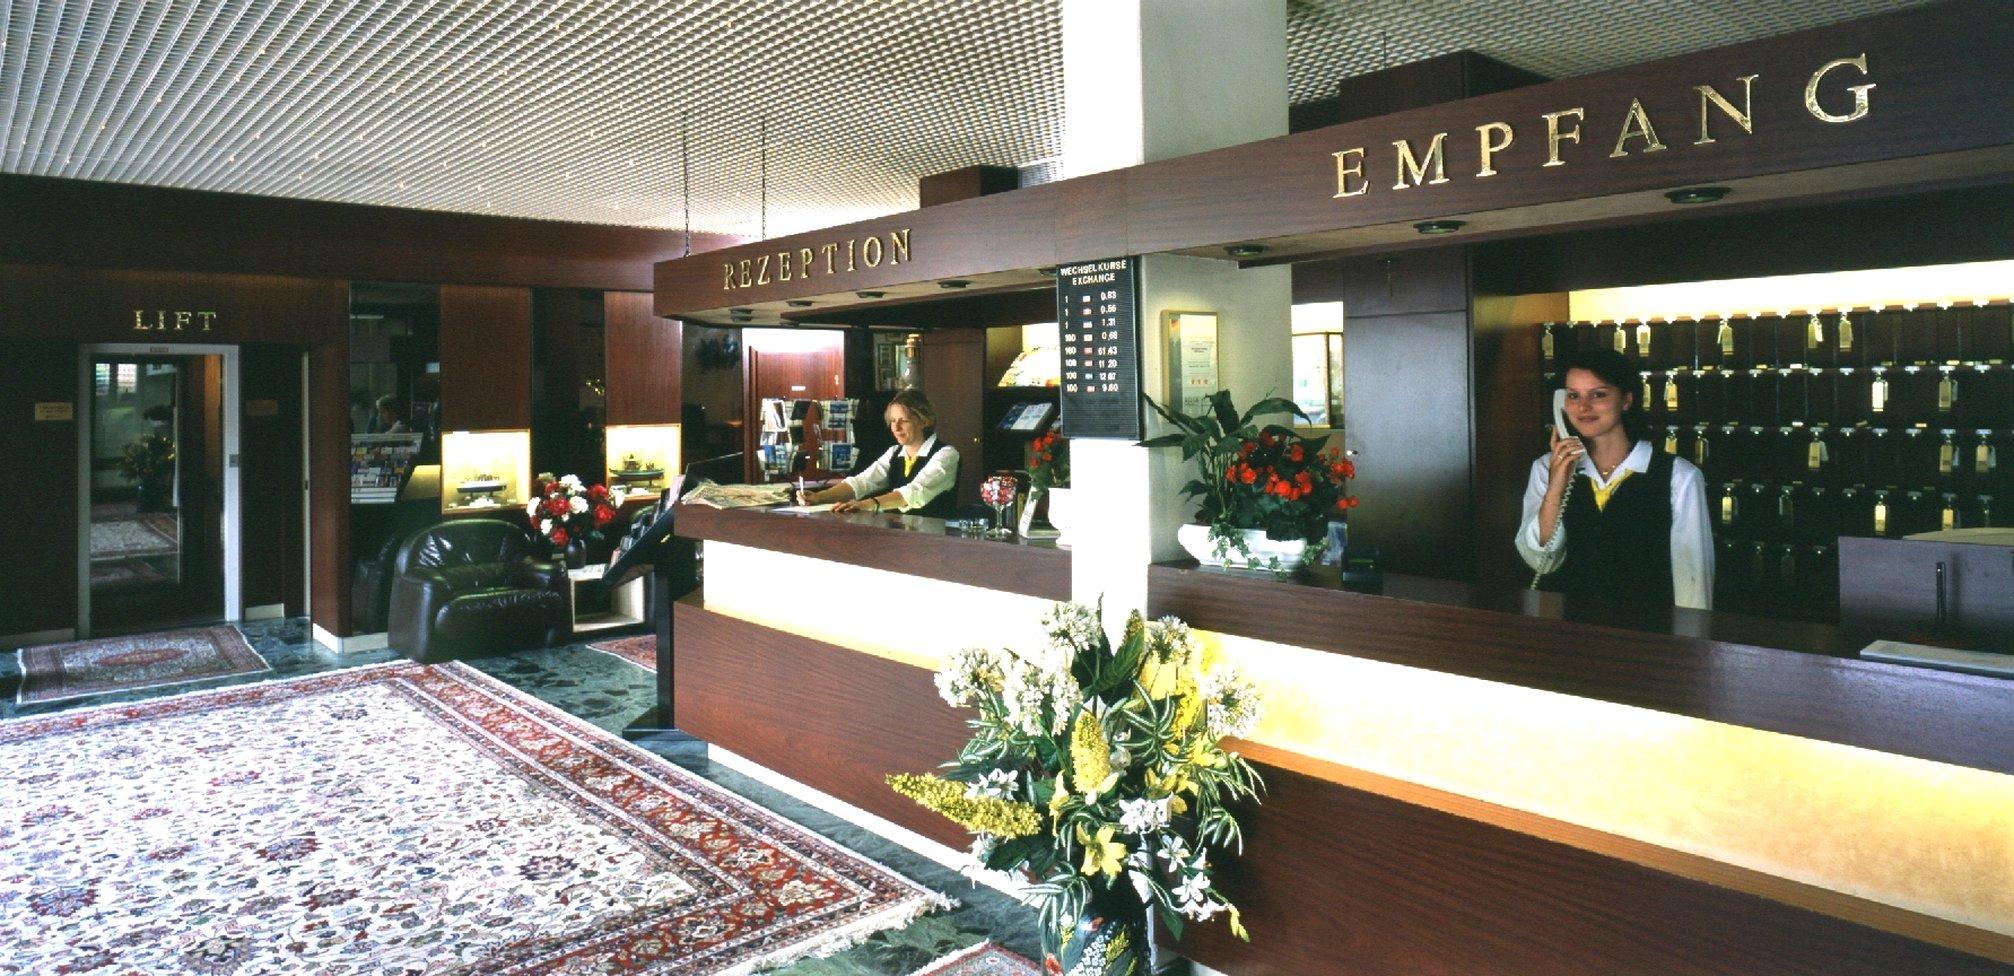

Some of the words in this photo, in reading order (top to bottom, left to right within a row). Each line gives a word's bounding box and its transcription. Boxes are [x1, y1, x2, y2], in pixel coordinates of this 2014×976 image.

[1332, 53, 1877, 199] EMPFANG
[723, 228, 912, 290] REZEPTION
[1060, 260, 1127, 276] WECHSELKURSE
[1072, 272, 1116, 286] EXCHANGE
[1065, 295, 1069, 303] 1
[133, 309, 217, 331] LIFT
[1065, 308, 1069, 317] 1
[1065, 321, 1069, 329] 1
